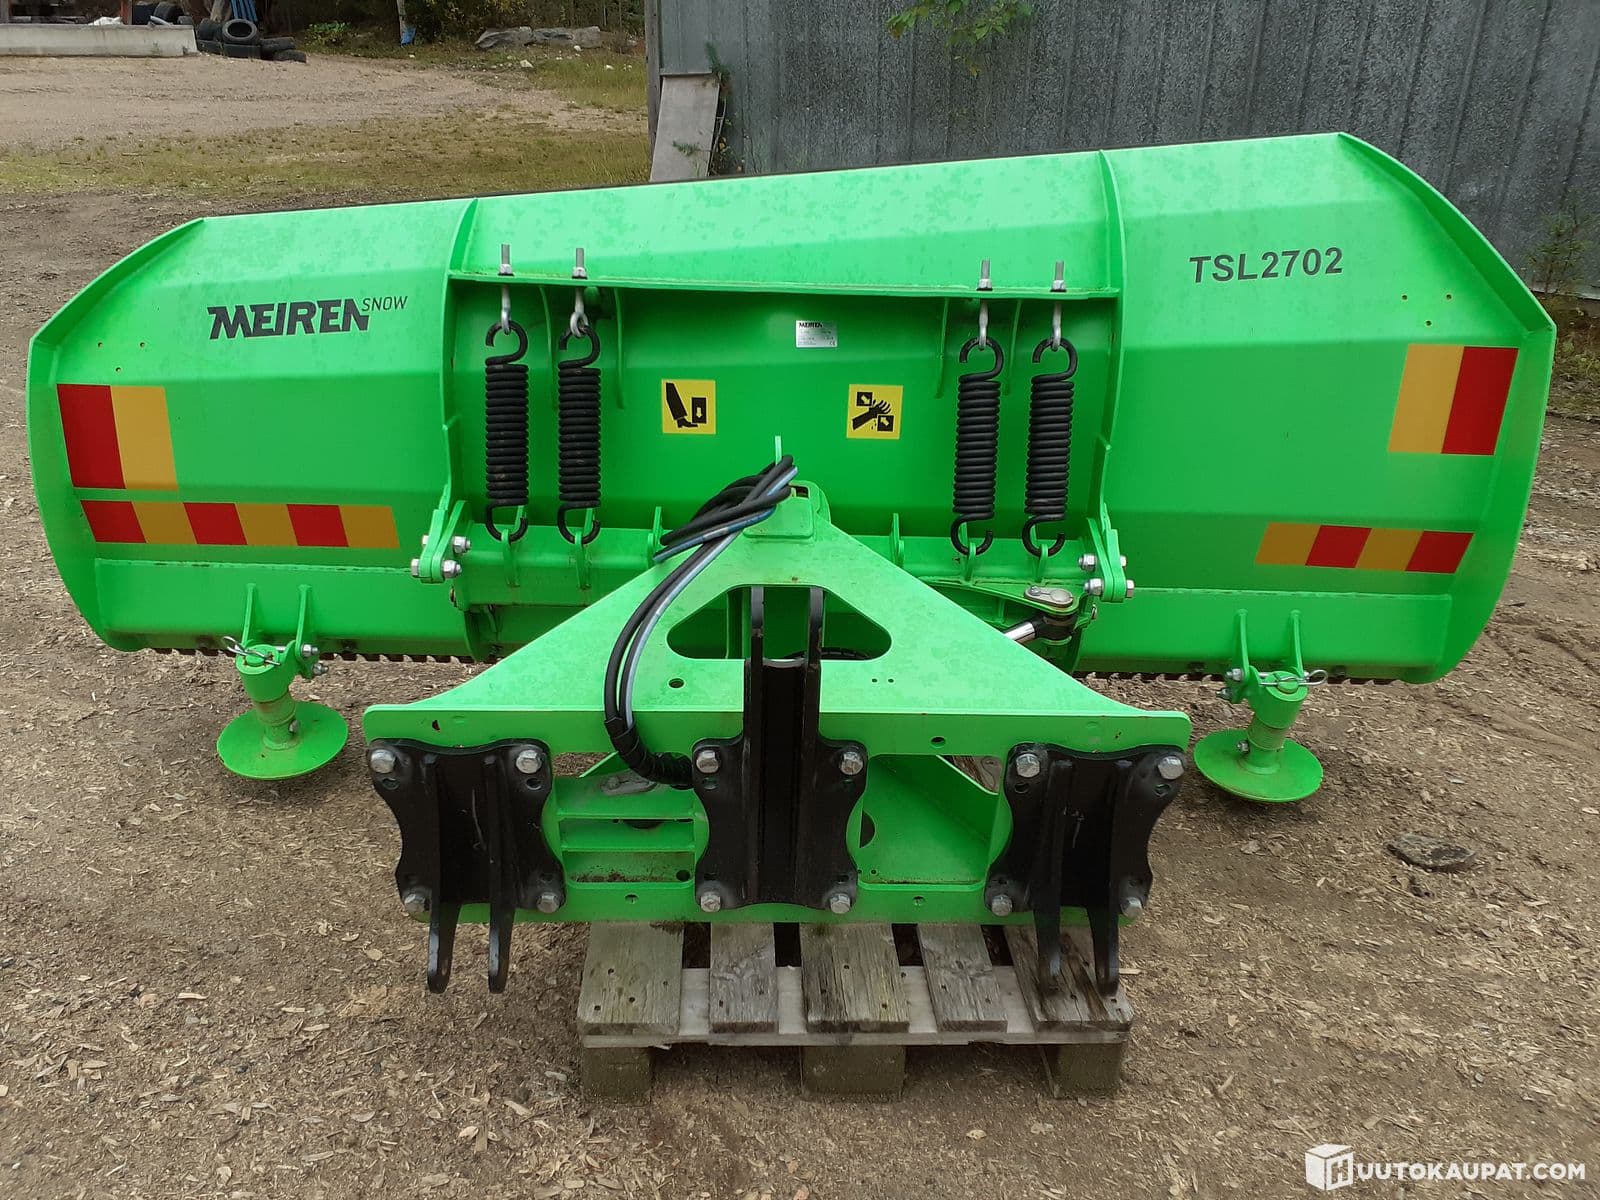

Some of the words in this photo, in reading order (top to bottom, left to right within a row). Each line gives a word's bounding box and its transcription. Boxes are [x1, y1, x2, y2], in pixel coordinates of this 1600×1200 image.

[1189, 247, 1343, 283] TSL2702
[207, 298, 369, 340] MEIREN
[361, 296, 408, 312] SNOW
